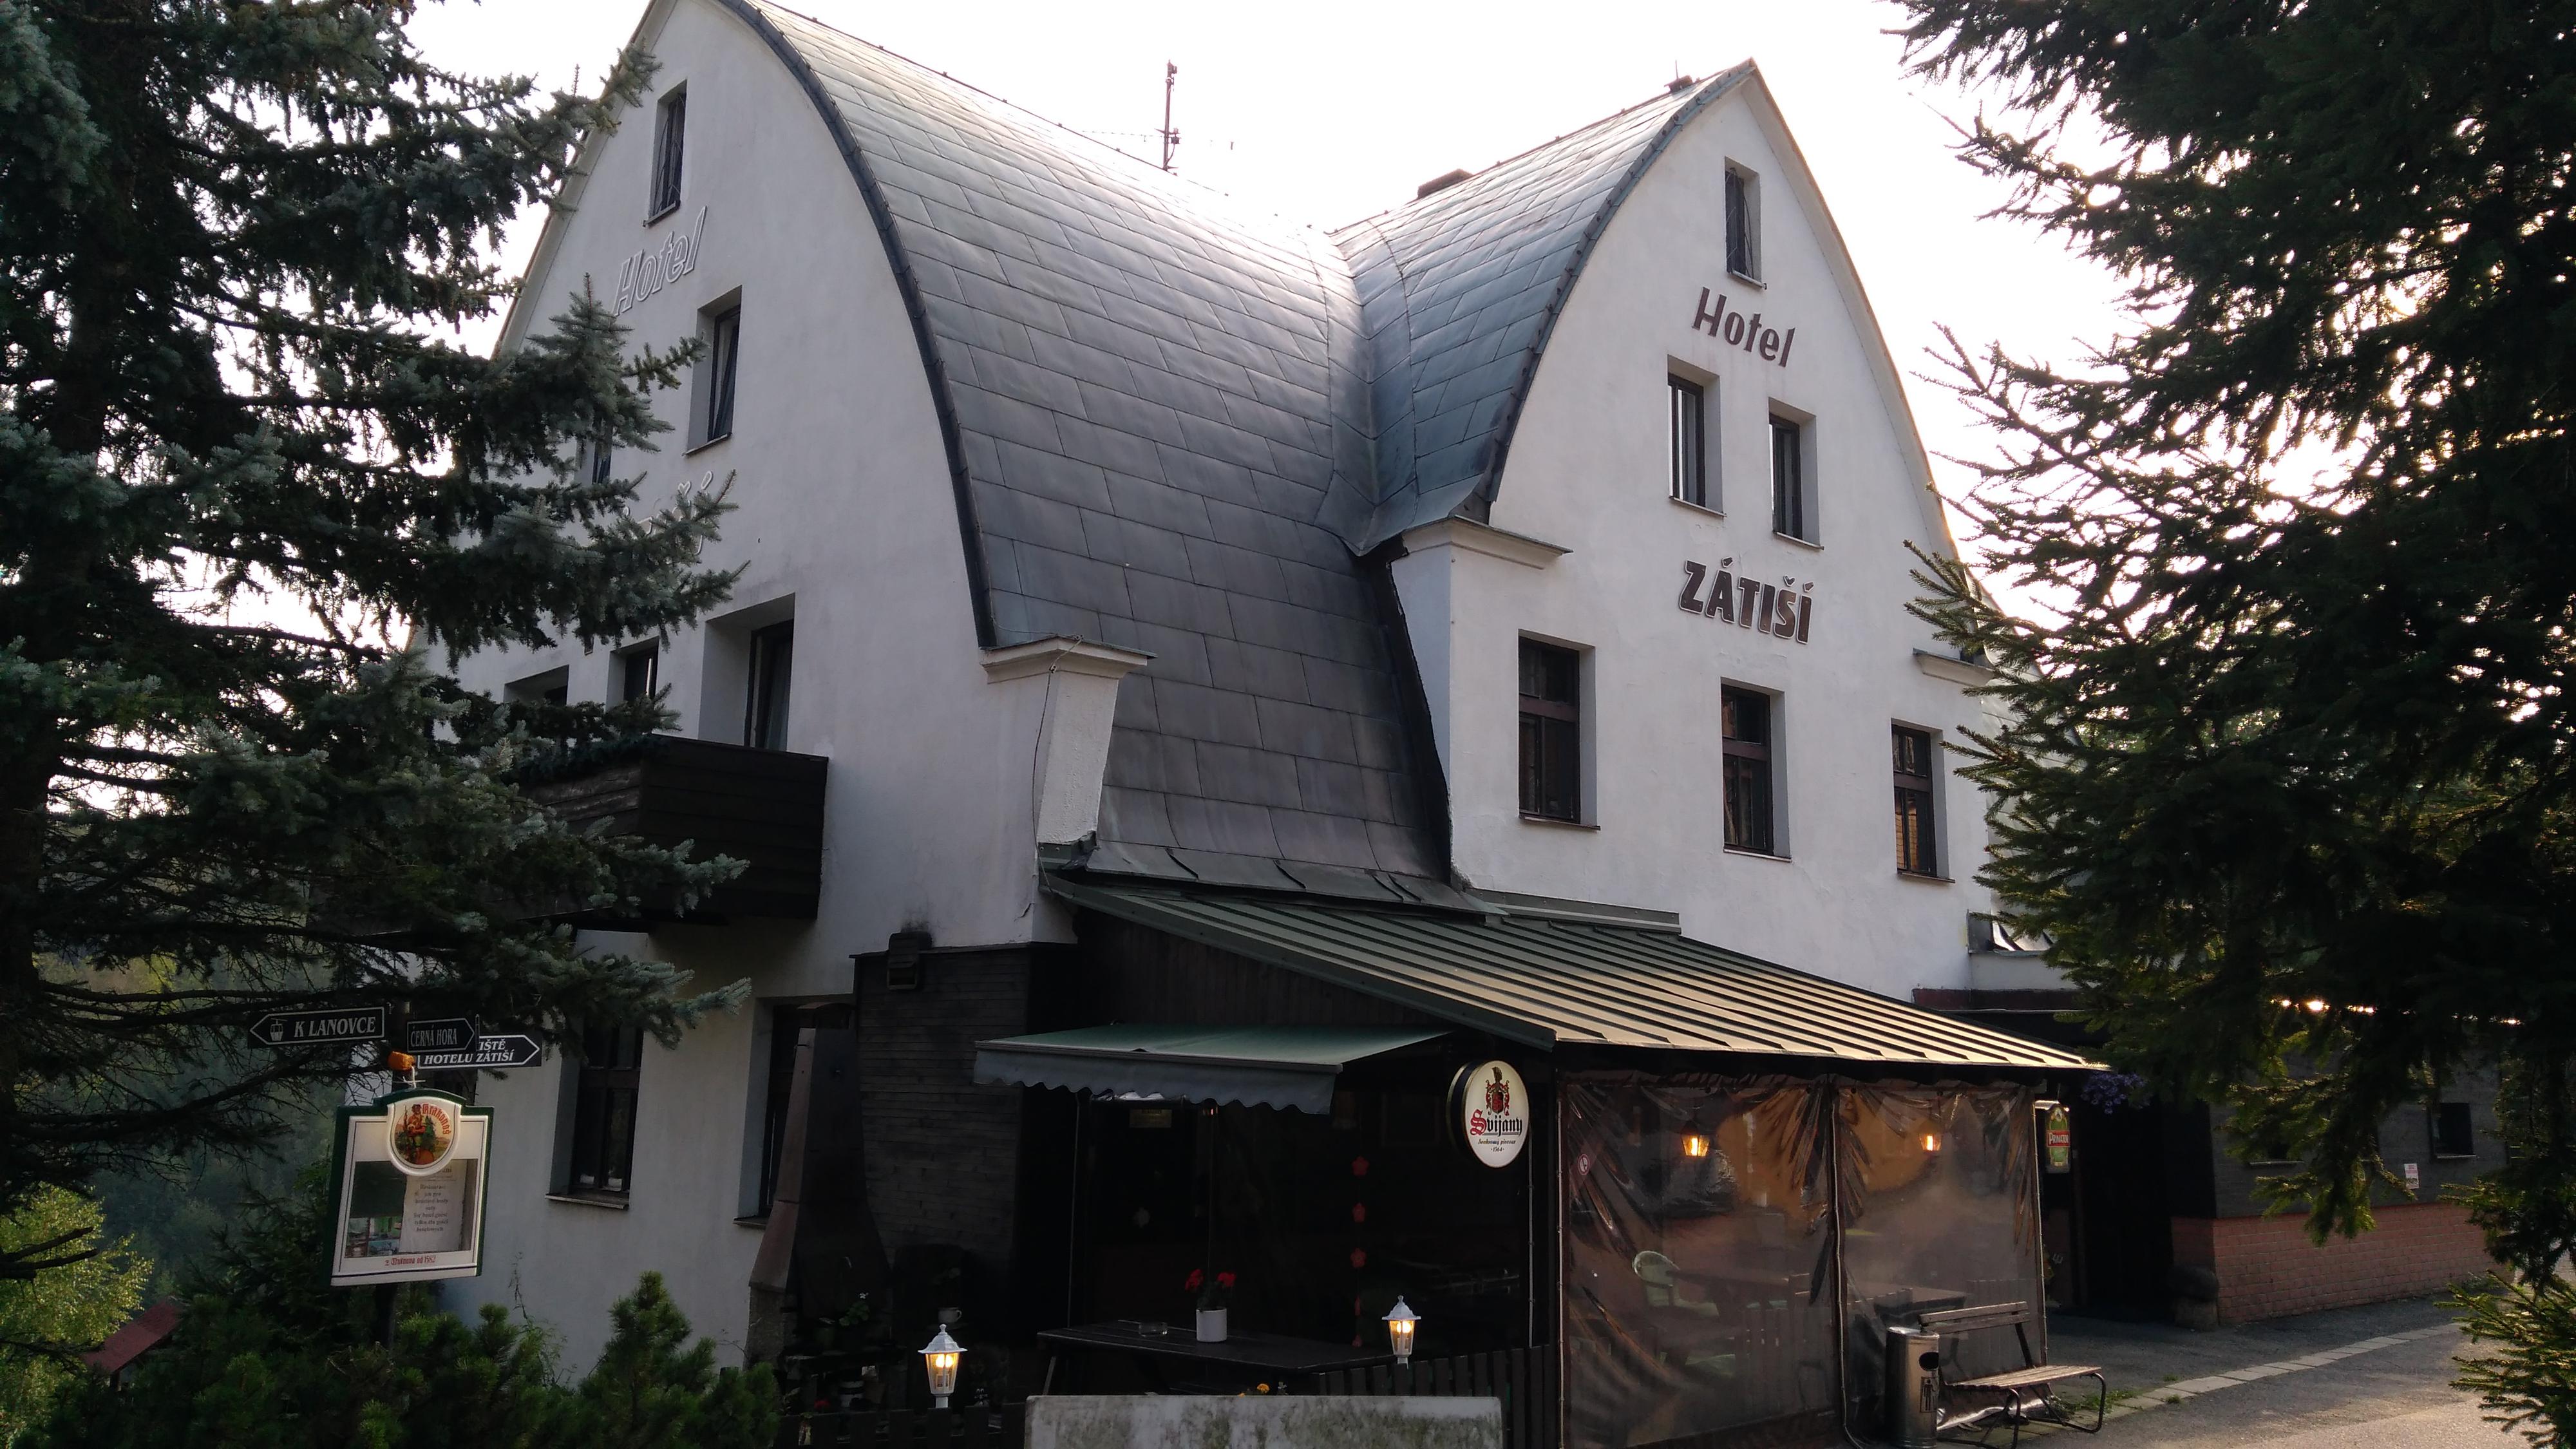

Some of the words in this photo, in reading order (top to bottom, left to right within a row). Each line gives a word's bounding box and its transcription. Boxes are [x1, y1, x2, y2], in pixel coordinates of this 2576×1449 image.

[612, 205, 707, 317] Hotel
[1692, 286, 1795, 368] Hotel
[1679, 556, 1814, 644] ZÁTIŠÍ
[294, 1020, 305, 1037] K
[308, 1016, 376, 1037] LANOVCE
[410, 1024, 435, 1046] ČERNÁ
[436, 1028, 458, 1046] HORA
[424, 1054, 473, 1065] HOTELU
[476, 1049, 515, 1063] ZÁTIŠÍ
[478, 1039, 506, 1051] IŠTĚ
[1470, 1109, 1522, 1137] Svijany
